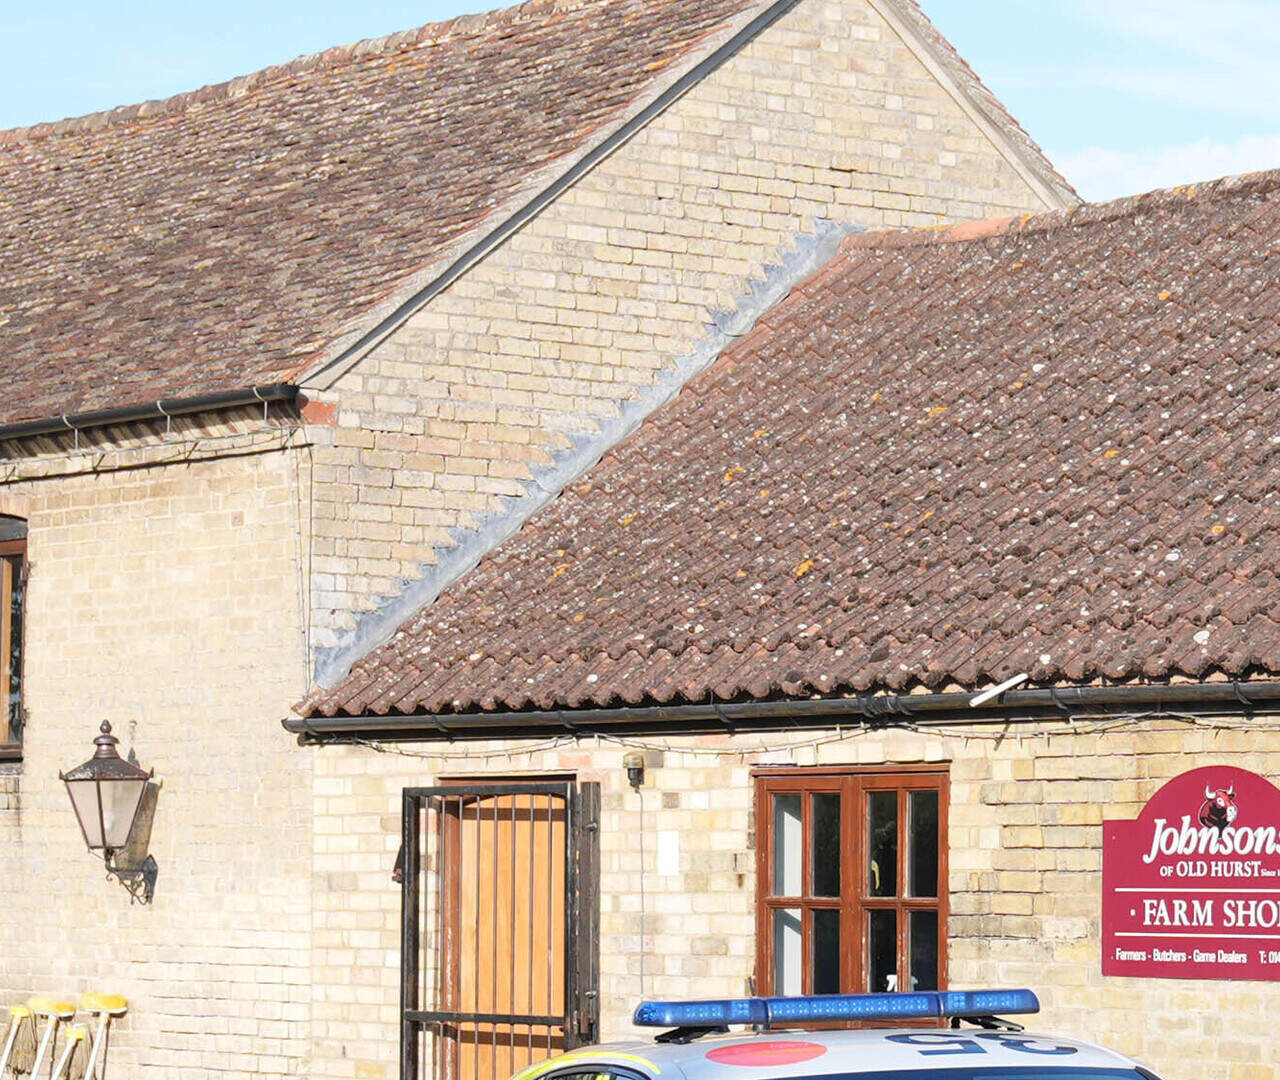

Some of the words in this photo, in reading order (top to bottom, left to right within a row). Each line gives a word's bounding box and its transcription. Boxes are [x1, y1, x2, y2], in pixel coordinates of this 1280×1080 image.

[1160, 865, 1174, 877] OF
[1176, 861, 1208, 877] OLD
[1210, 860, 1261, 877] HURST
[1142, 899, 1214, 927] FARM
[1115, 947, 1147, 961] Farmers
[1152, 948, 1187, 962] Butchers
[1193, 949, 1216, 963] Game
[1217, 949, 1247, 963] Dealers
